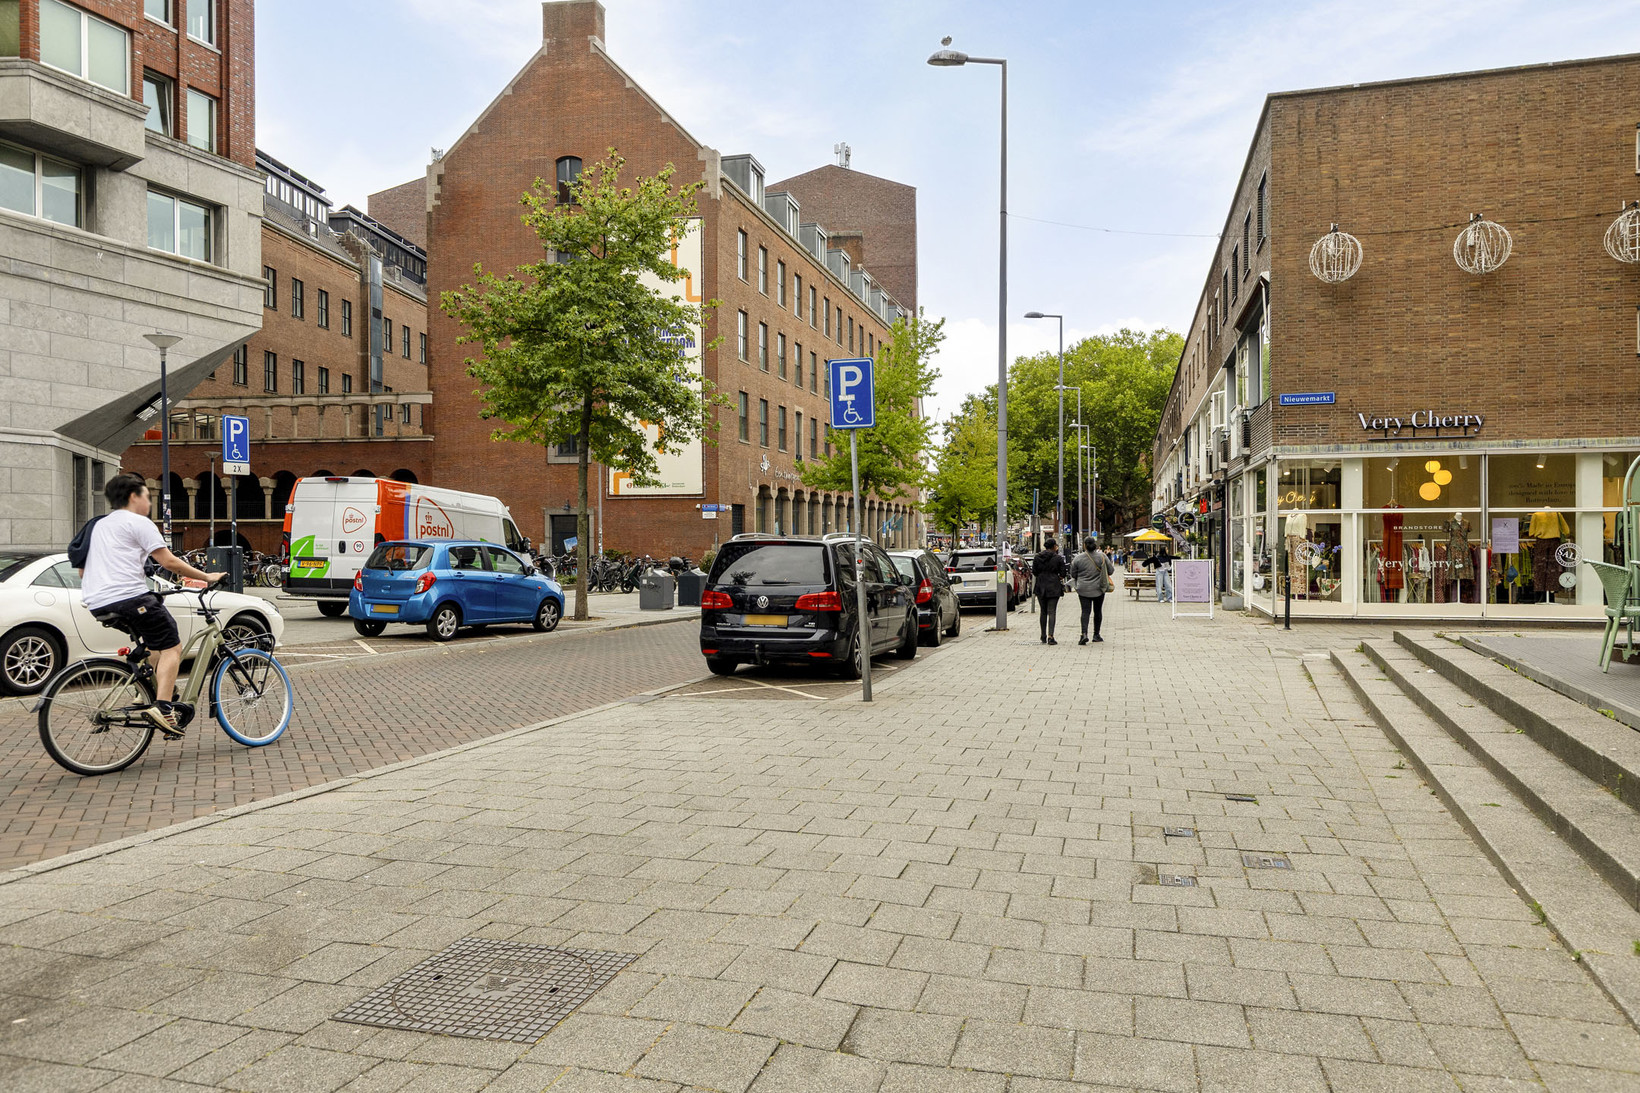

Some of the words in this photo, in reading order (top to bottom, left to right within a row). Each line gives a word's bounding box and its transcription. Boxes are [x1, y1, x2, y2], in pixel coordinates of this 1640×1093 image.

[840, 366, 863, 396] P
[1284, 394, 1330, 403] Nieuwemarkt
[1357, 412, 1405, 434] Very
[1411, 410, 1486, 432] Cherry
[230, 419, 244, 442] P
[345, 517, 364, 525] postnl
[420, 524, 450, 539] postnl
[1376, 557, 1405, 571] Very
[1408, 557, 1452, 571] Cerry
